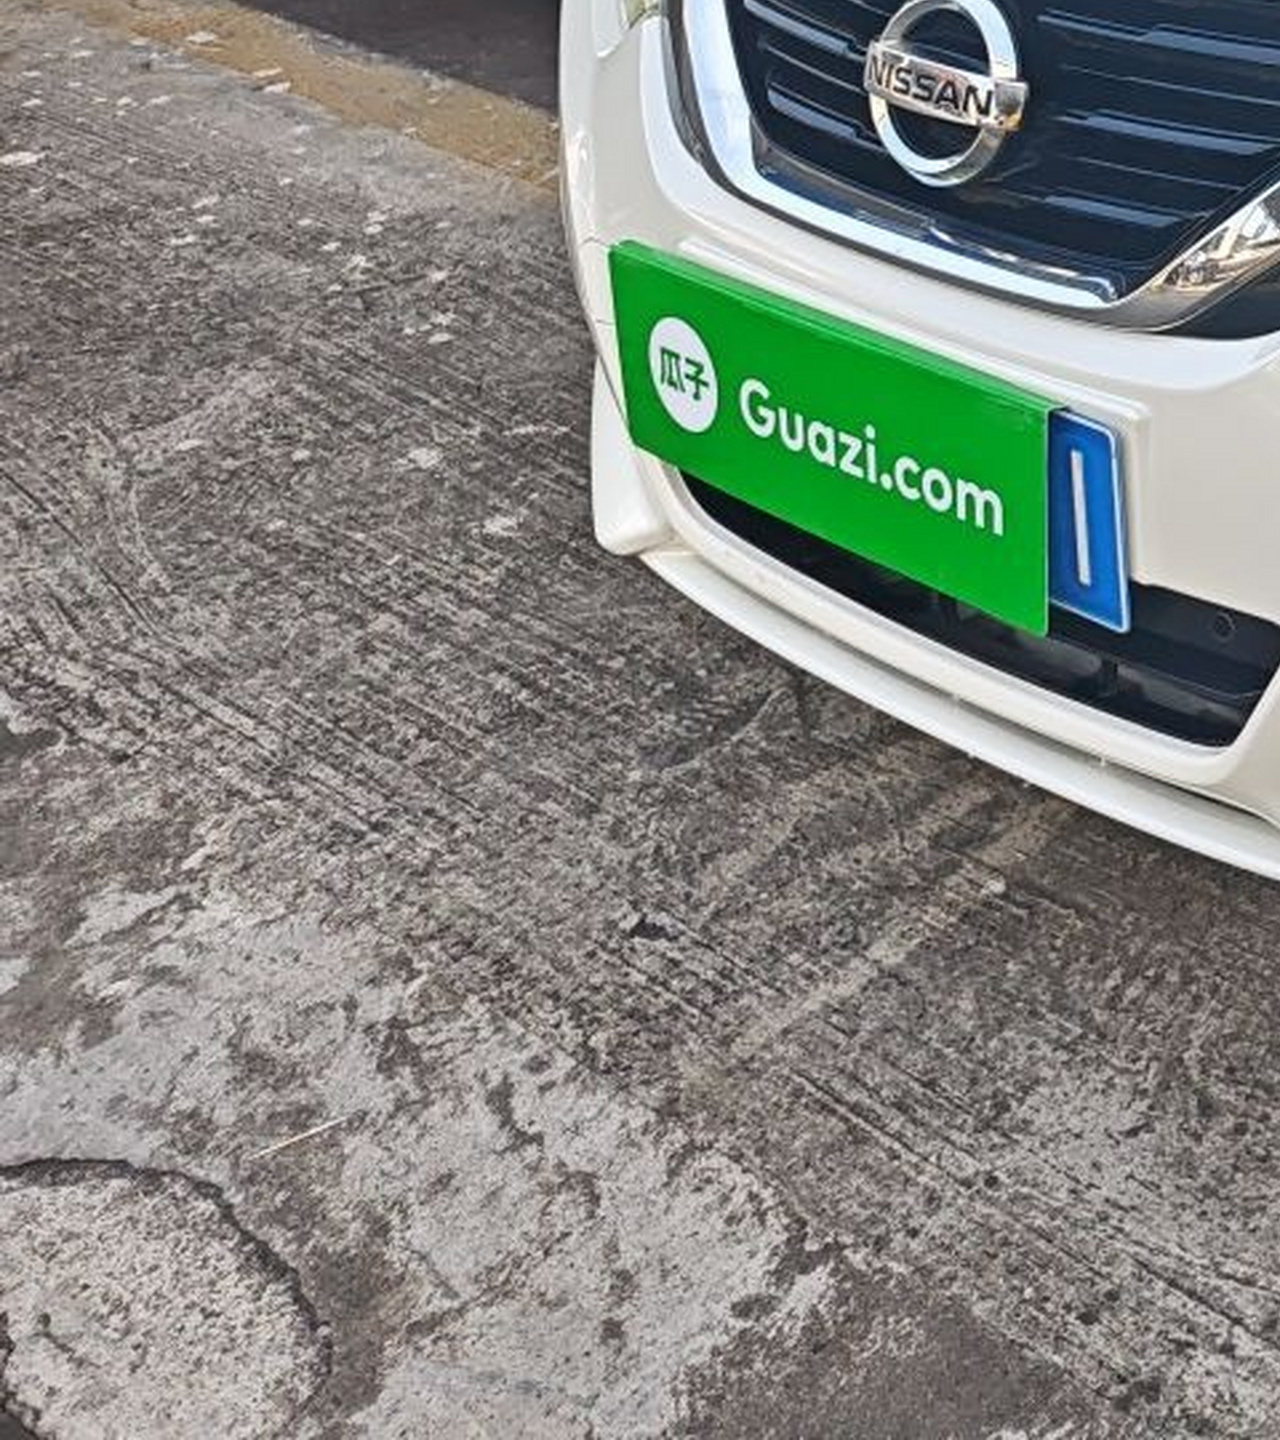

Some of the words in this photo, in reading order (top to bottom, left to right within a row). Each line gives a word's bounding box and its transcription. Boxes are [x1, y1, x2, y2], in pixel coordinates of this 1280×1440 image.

[868, 55, 994, 117] NISSAN
[659, 345, 710, 401] 瓜子
[739, 378, 1004, 537] Guazi.com
